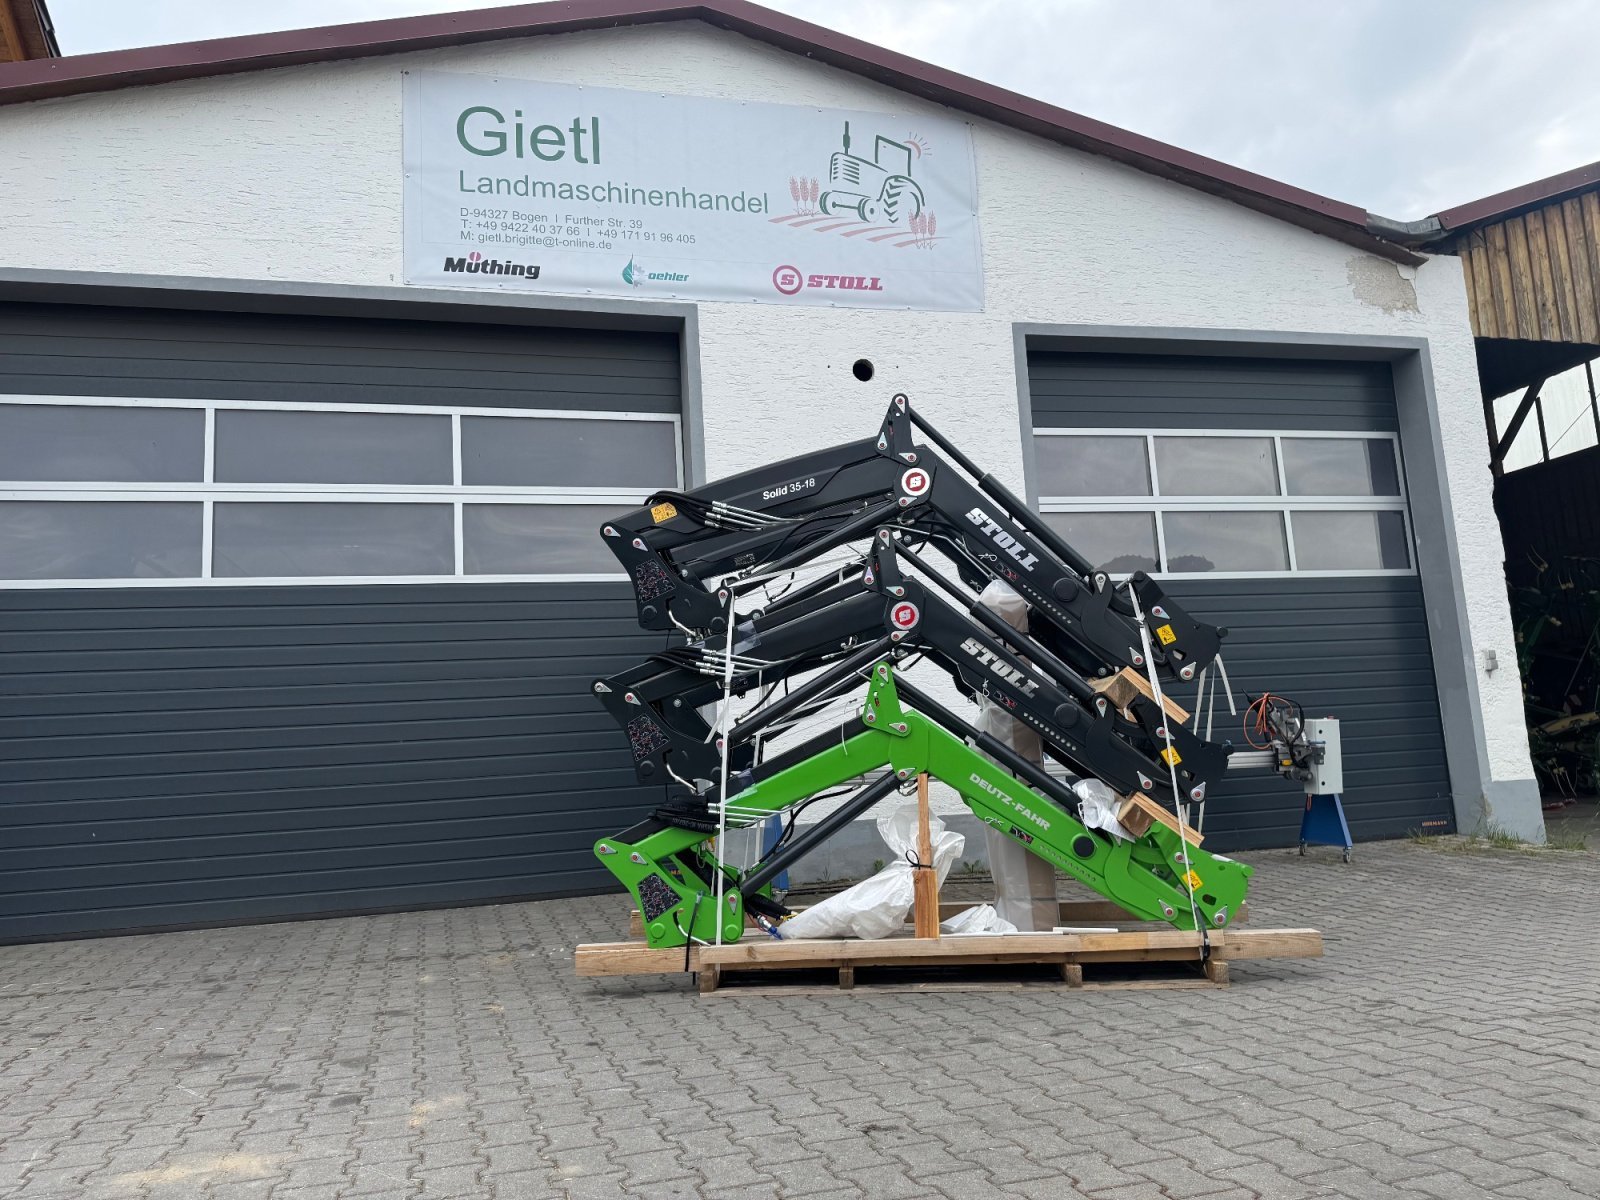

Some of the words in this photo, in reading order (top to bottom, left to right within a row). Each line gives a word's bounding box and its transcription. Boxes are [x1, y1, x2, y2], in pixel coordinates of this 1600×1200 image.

[456, 105, 600, 165] Gietl
[459, 169, 769, 214] Landmaschinenhandel
[460, 207, 508, 220] D-94327
[512, 210, 548, 224] Bogen
[565, 214, 605, 227] Further
[607, 217, 626, 228] Str.
[629, 219, 643, 229] 39
[460, 219, 472, 229] T:
[475, 220, 498, 231] +49
[500, 221, 529, 233] 9422
[532, 224, 546, 234] 40
[549, 225, 563, 235] 37
[566, 226, 580, 236] 66
[597, 229, 618, 239] +49
[621, 230, 640, 240] 171
[643, 231, 657, 241] 91
[660, 232, 674, 243] 96
[676, 234, 696, 244] 405
[460, 230, 475, 241] M:
[477, 232, 612, 250] gietl.brigitte@t-online.de
[443, 252, 541, 280] Müthing
[647, 271, 690, 282] oehler
[806, 274, 883, 291] STOLL
[762, 485, 788, 501] Solid
[789, 477, 816, 494] 35-18
[964, 507, 1040, 572] STOLL
[959, 636, 1040, 699] STOLL
[969, 772, 1051, 831] DEUTZ-FAHR
